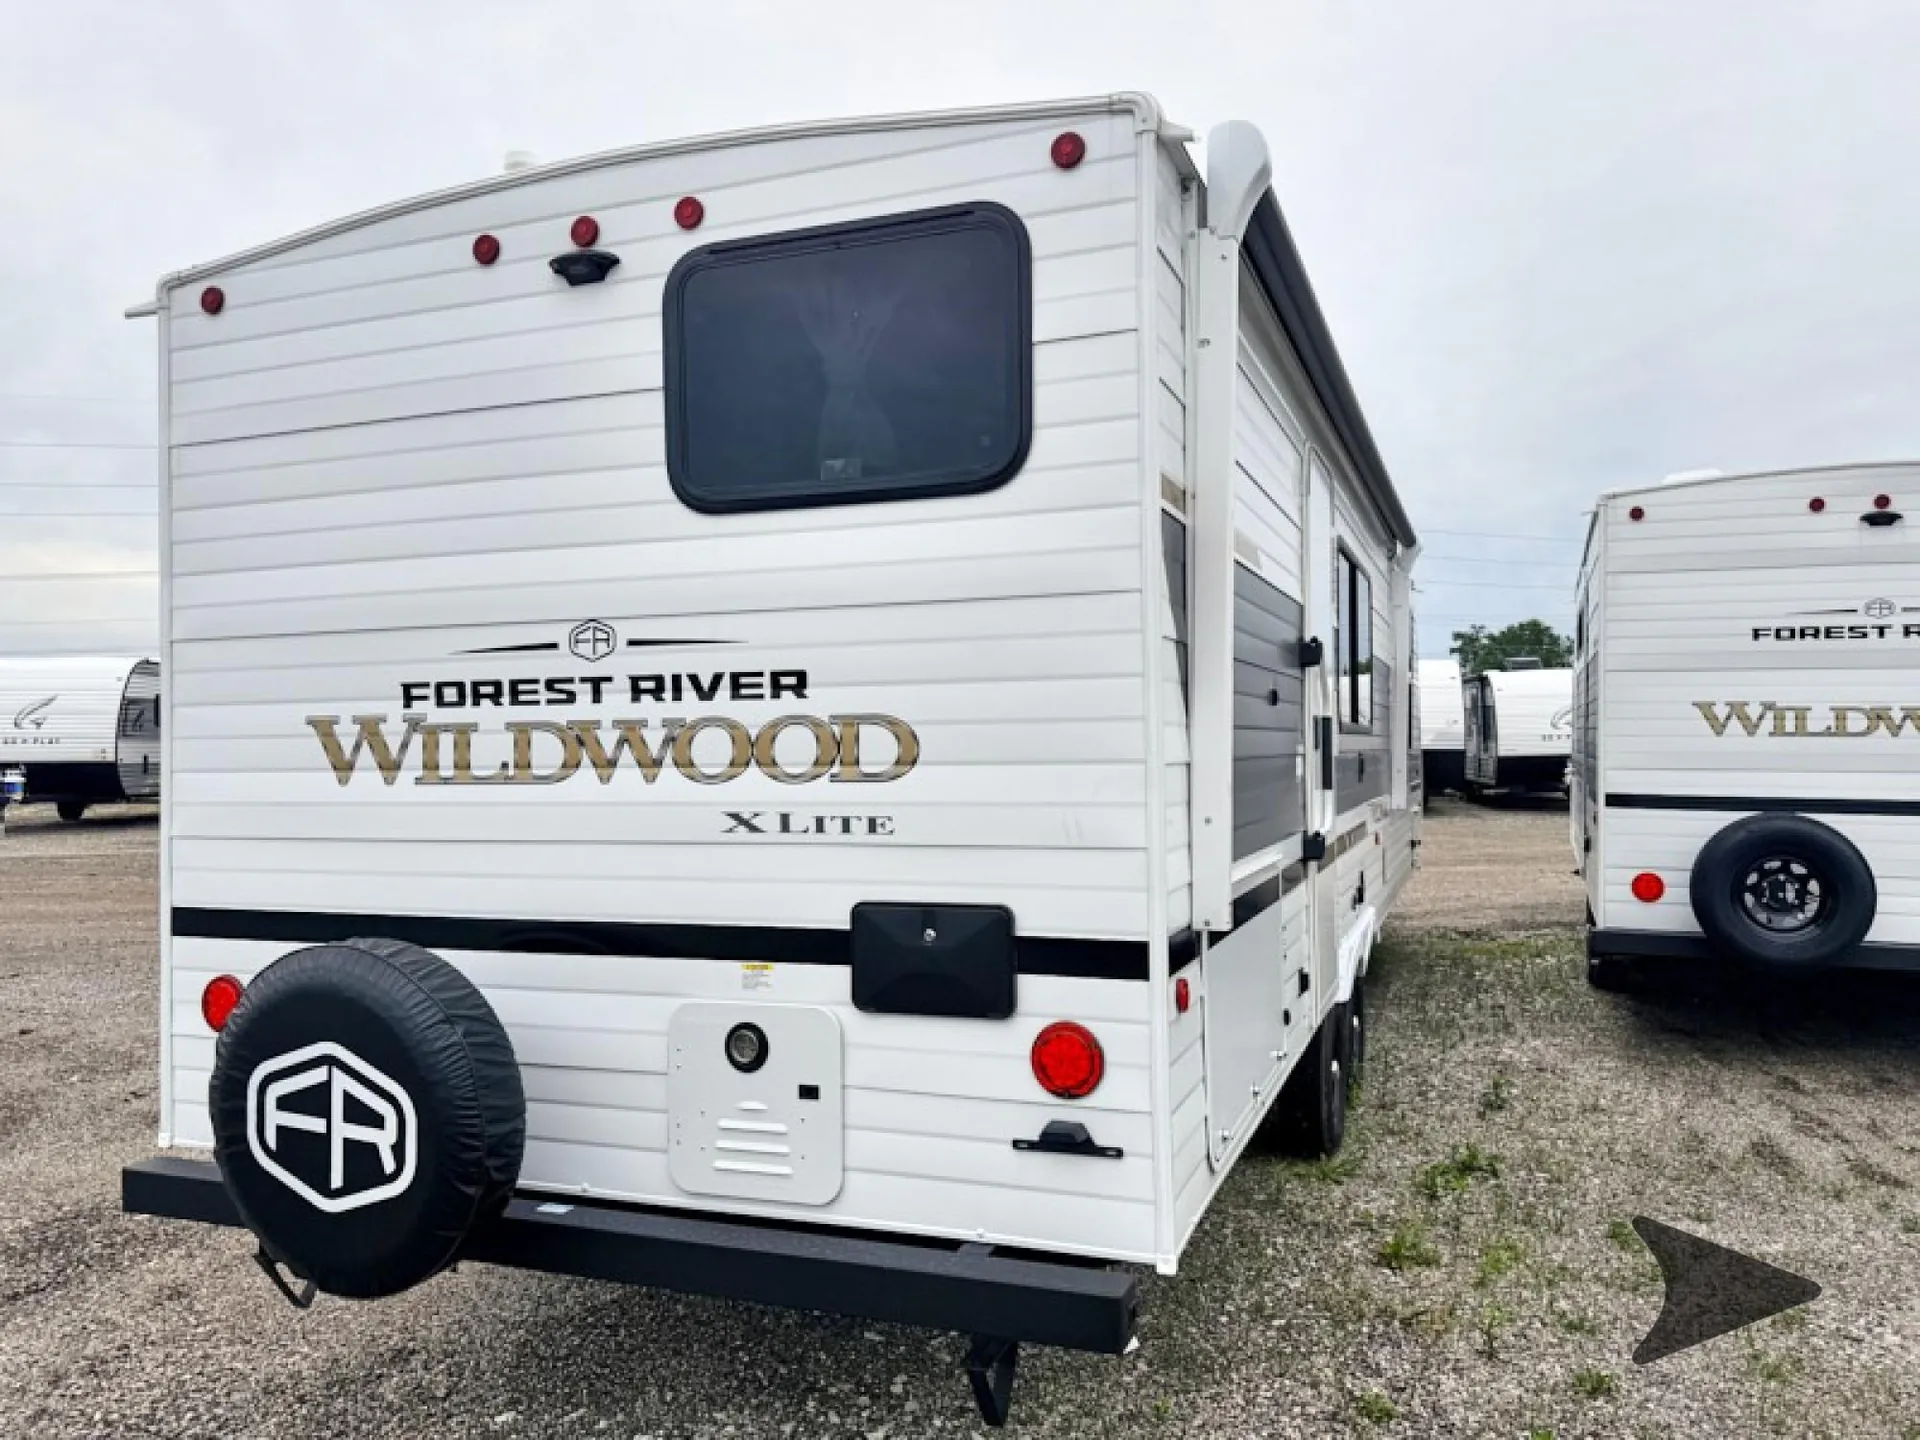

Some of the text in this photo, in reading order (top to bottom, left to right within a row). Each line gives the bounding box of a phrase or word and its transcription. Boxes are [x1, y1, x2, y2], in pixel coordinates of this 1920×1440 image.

[1752, 624, 1893, 641] FOREST
[401, 669, 809, 708] FOREST RIVER
[306, 714, 920, 785] WILDWOOD
[720, 811, 895, 835] X LITE
